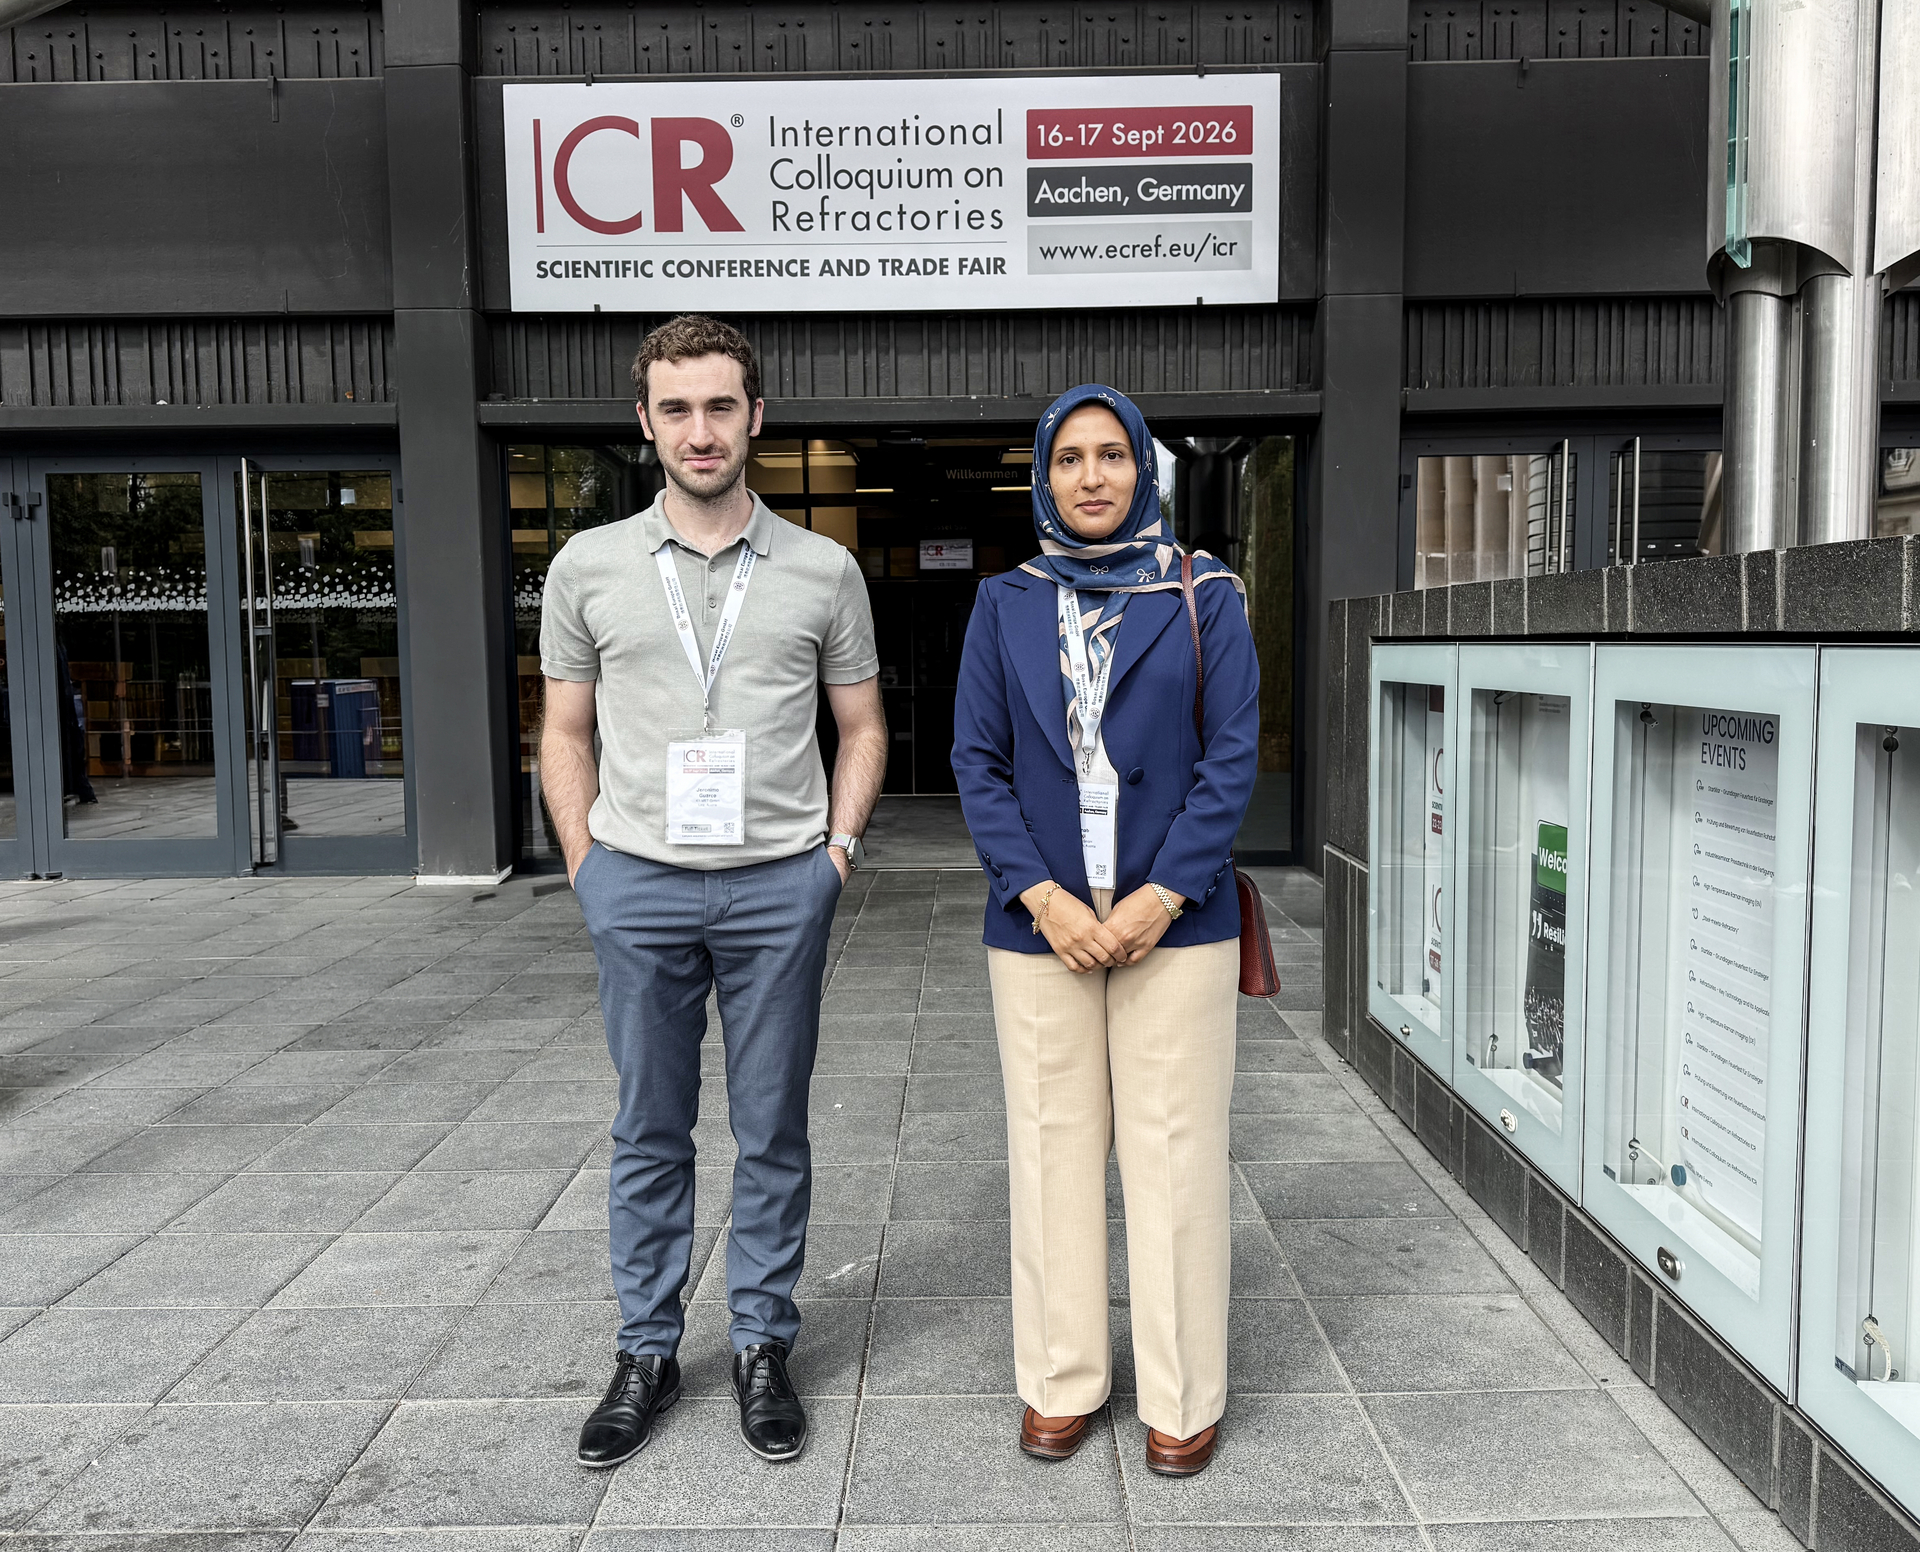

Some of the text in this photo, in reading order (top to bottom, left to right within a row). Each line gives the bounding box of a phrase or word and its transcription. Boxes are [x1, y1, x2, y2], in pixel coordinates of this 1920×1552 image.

[769, 107, 1003, 148] International
[1037, 120, 1237, 152] 16-17 Sept 2026
[769, 153, 1003, 201] Colloquium on
[1034, 177, 1246, 207] Aachen, Germany
[771, 198, 1004, 232] Refractories
[1039, 232, 1238, 262] www.ecref.eu/icr
[536, 256, 1007, 279] SCIENTIFIC CONFERENCE AND TRADE FAIR
[945, 469, 1018, 480] Willkommen
[1702, 713, 1775, 744] UPCOMING
[1701, 742, 1747, 771] EVENTS
[1539, 846, 1567, 874] Welco
